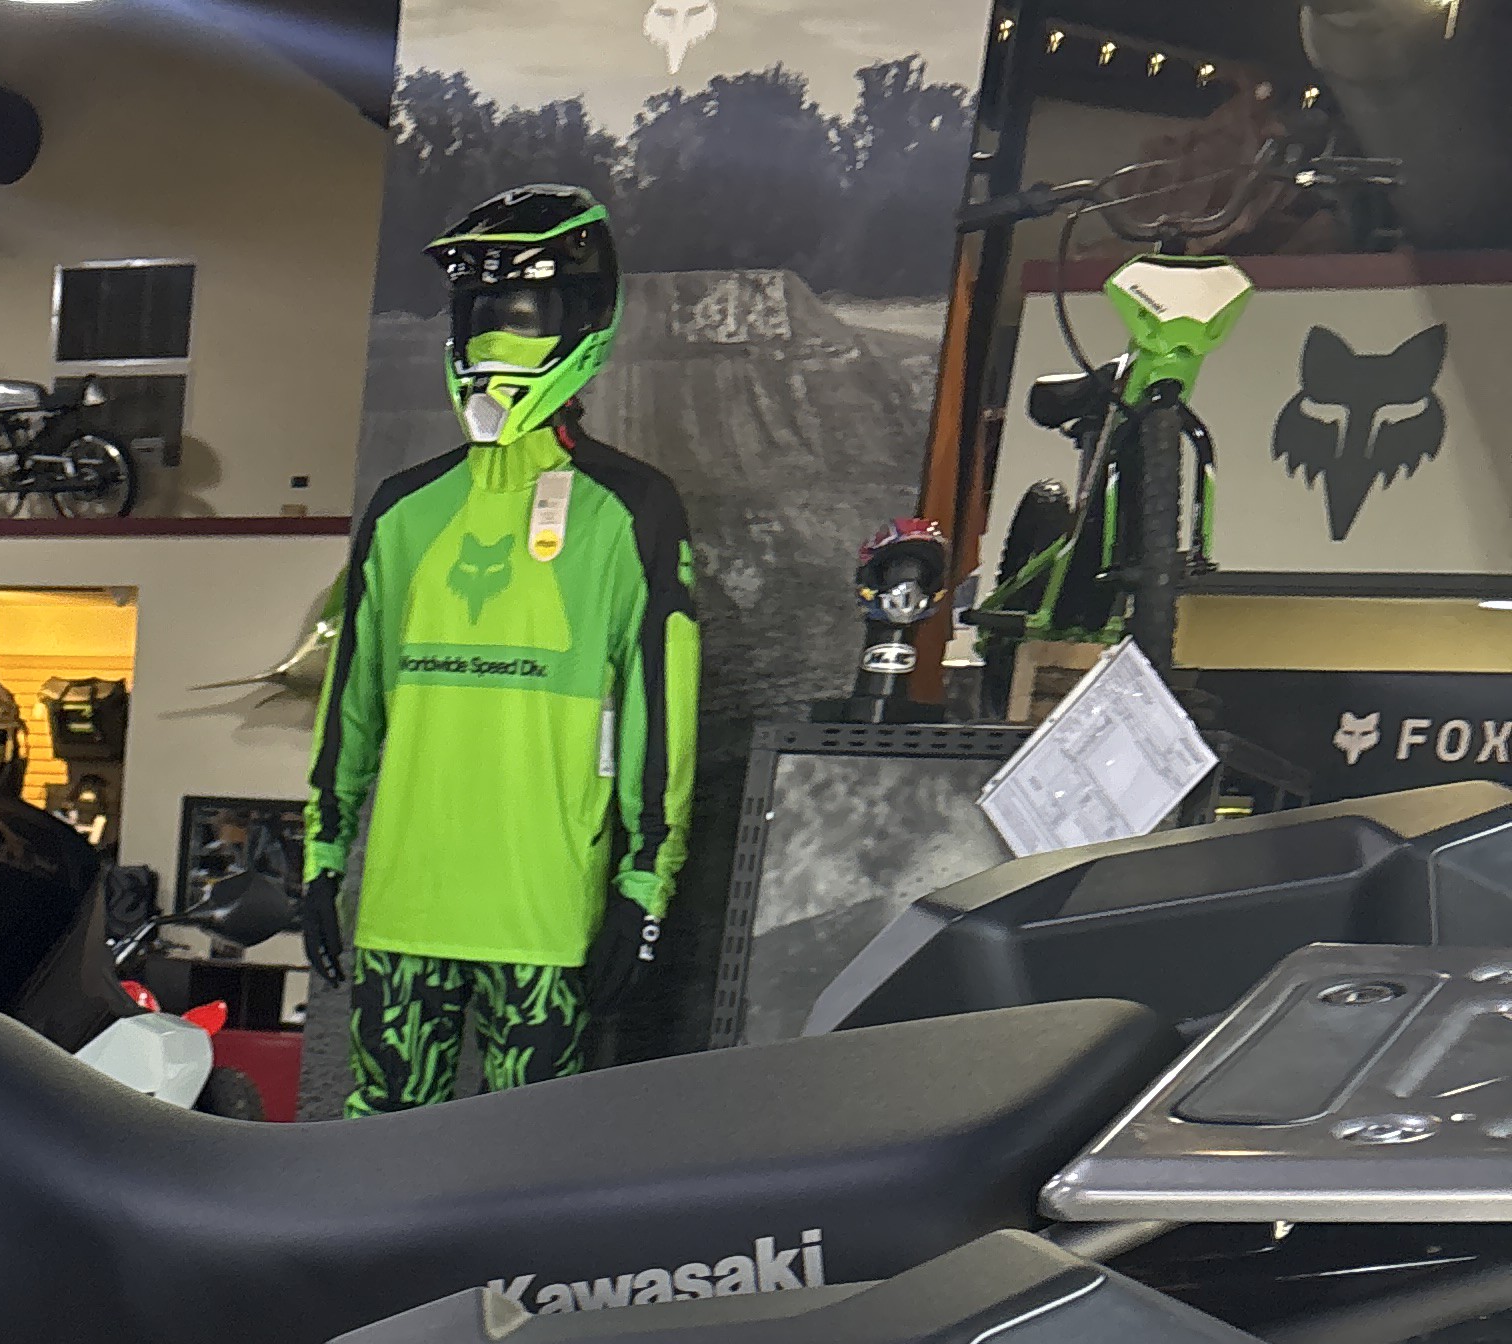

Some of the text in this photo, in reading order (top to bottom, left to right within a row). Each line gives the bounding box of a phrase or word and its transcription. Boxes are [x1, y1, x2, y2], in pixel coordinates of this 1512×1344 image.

[470, 655, 518, 678] Speed
[1395, 717, 1512, 763] FOX
[488, 1228, 825, 1316] Kawasaki
